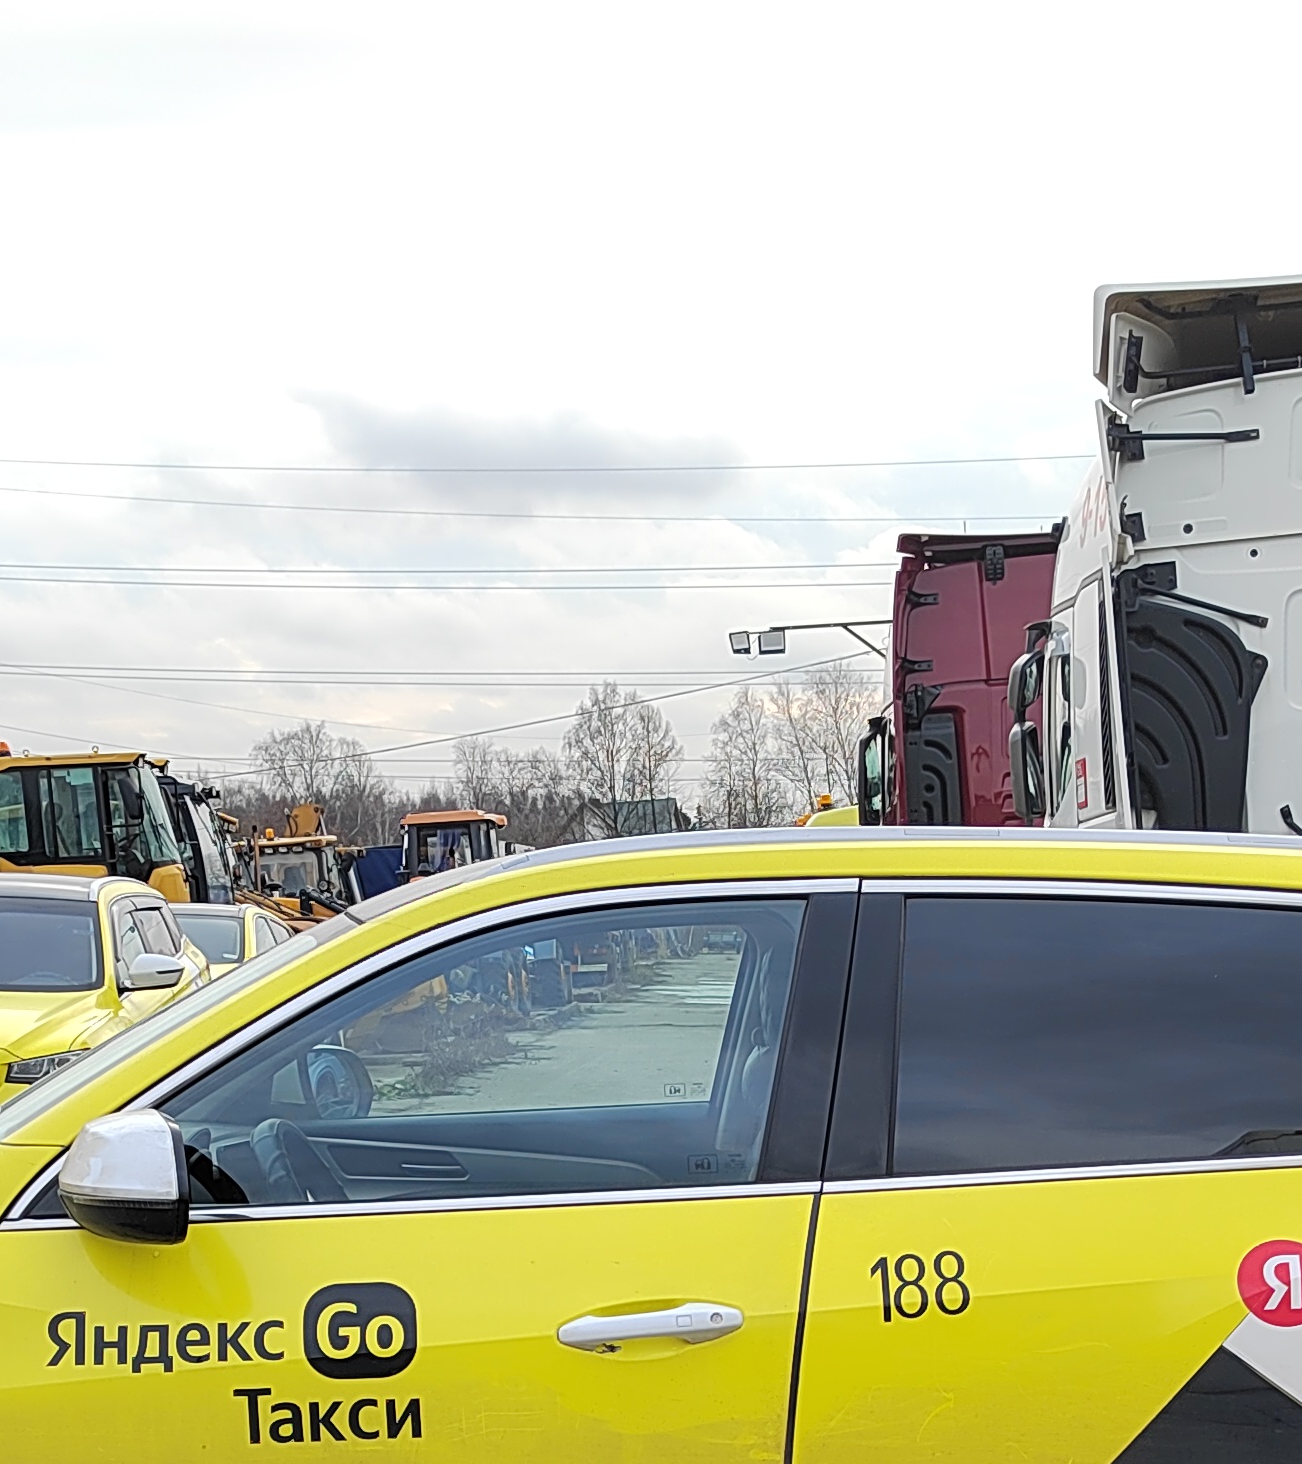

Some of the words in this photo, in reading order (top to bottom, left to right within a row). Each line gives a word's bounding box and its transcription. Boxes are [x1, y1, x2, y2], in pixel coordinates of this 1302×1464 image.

[869, 1250, 972, 1323] 188
[46, 1311, 285, 1374] Яндекс
[314, 1299, 407, 1362] Go
[232, 1387, 423, 1445] Такси
